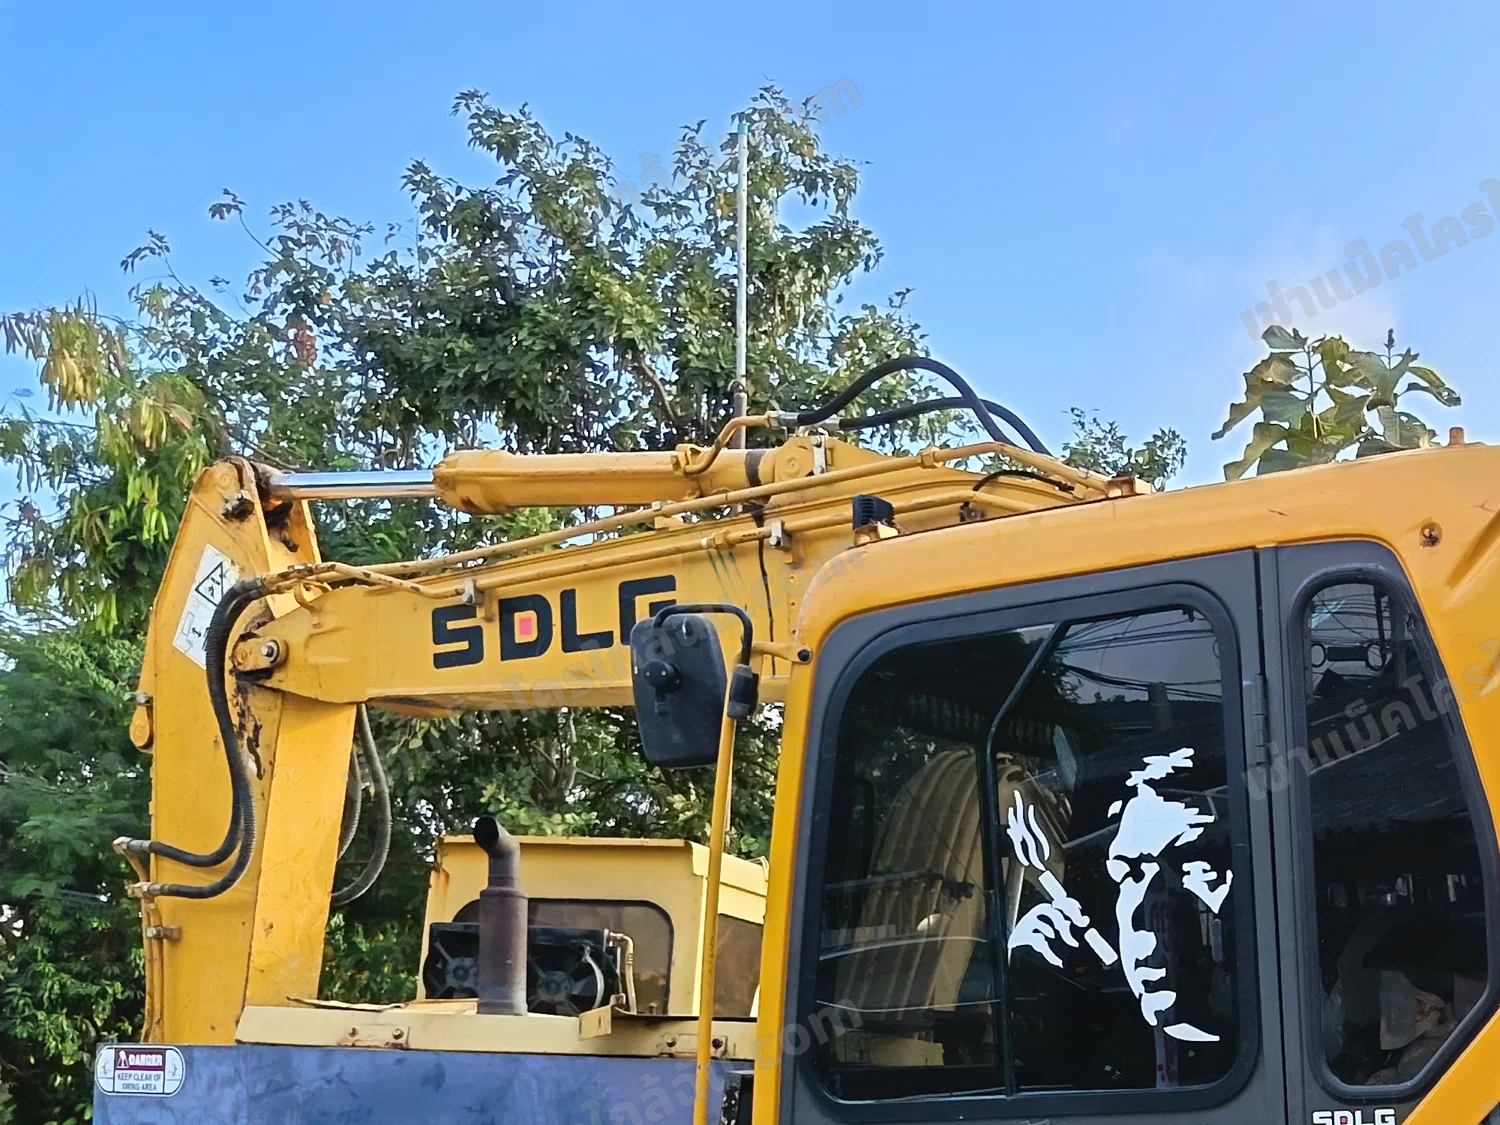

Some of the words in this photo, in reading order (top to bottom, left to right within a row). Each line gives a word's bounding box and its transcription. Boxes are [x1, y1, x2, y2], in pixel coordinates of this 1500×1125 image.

[433, 574, 677, 669] SDLG
[117, 1073, 133, 1081] KEEP
[133, 1073, 153, 1081] CLEAR
